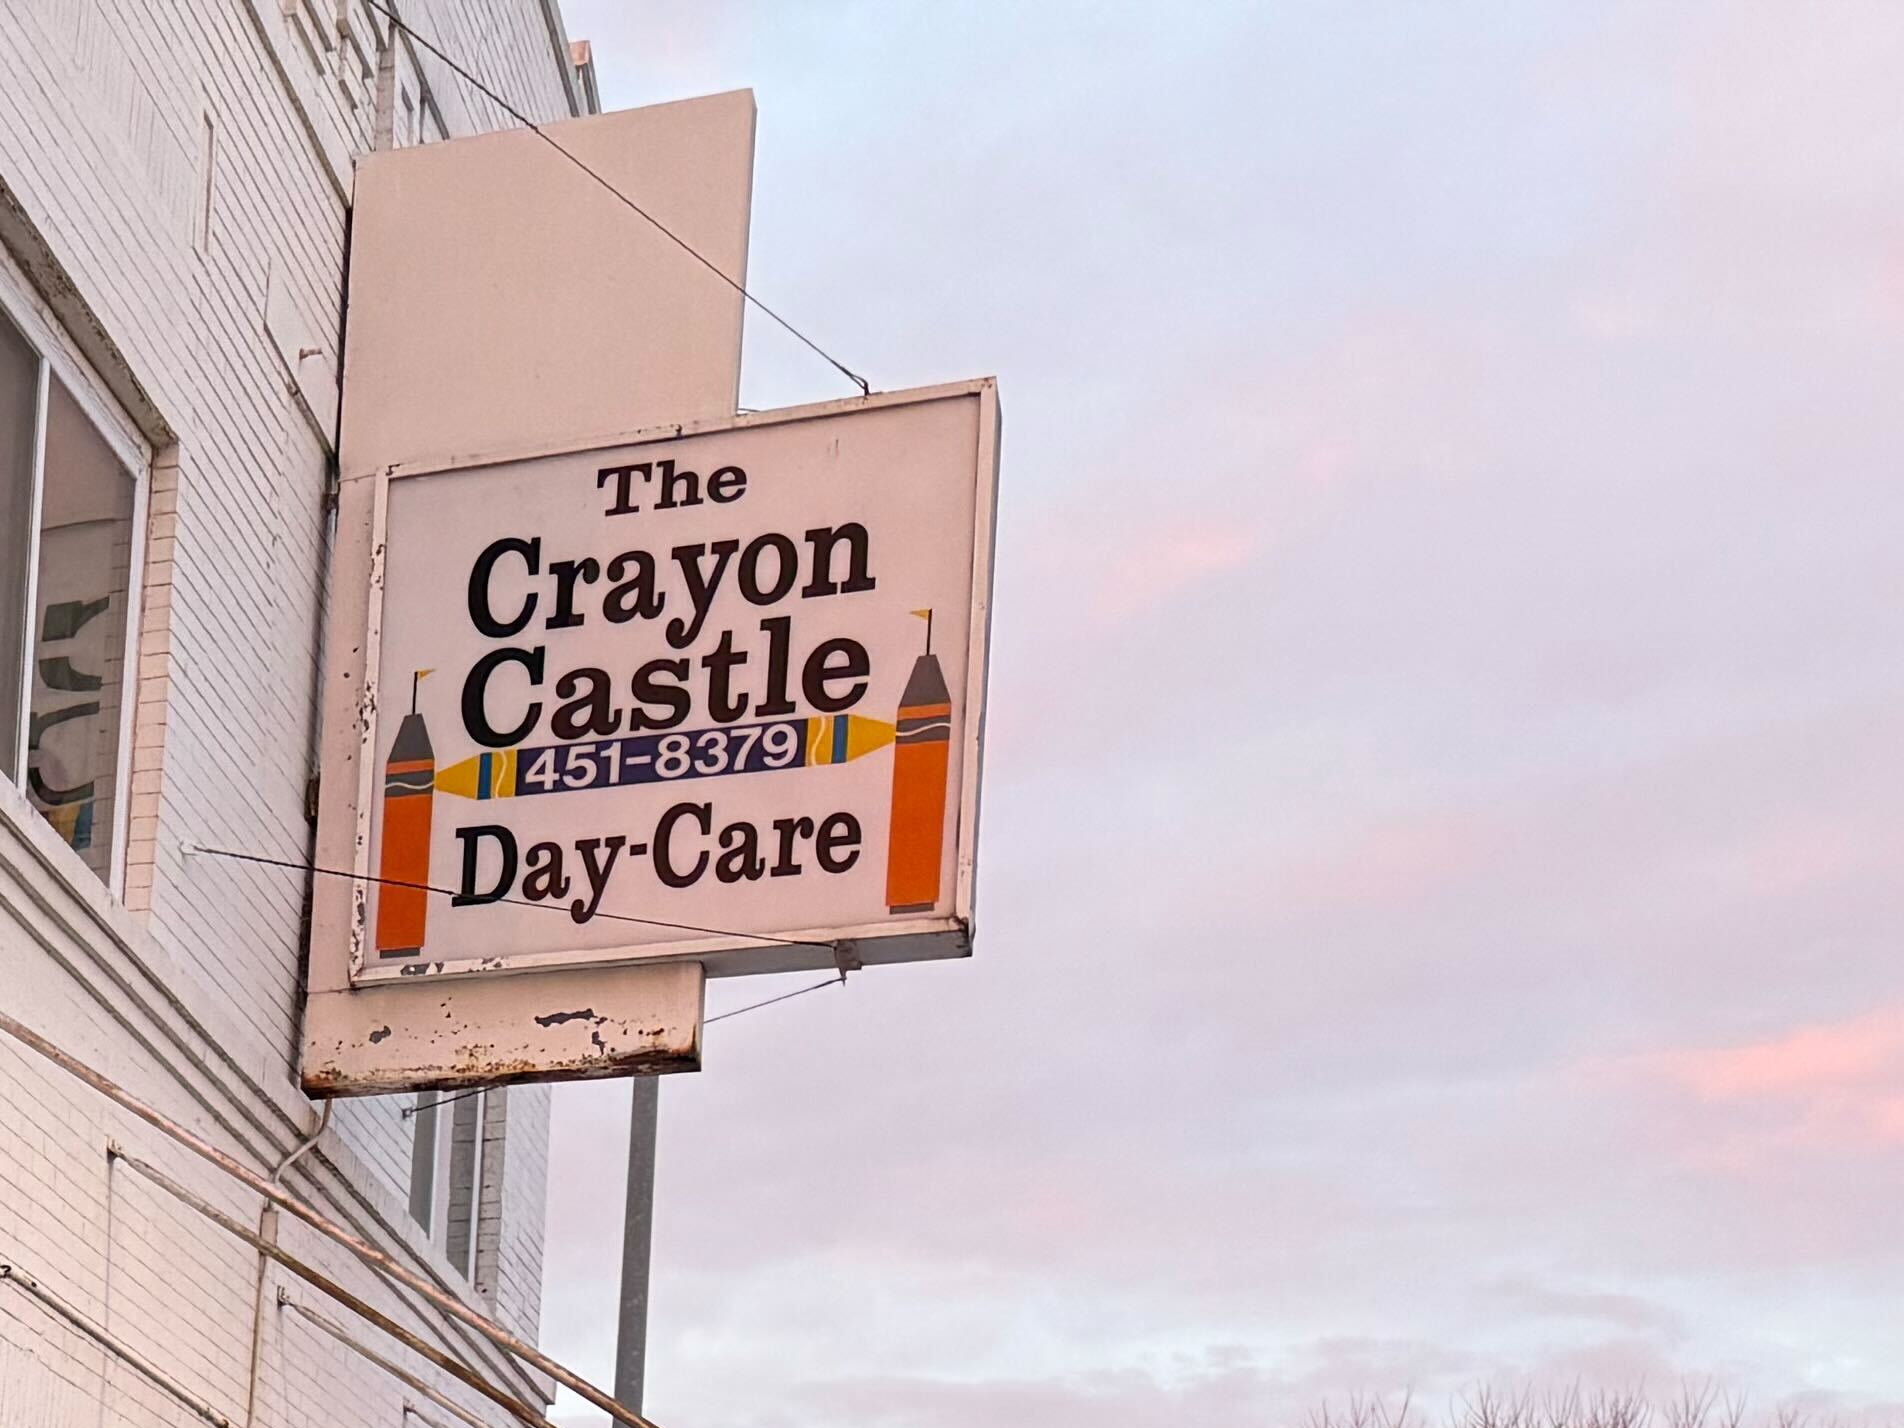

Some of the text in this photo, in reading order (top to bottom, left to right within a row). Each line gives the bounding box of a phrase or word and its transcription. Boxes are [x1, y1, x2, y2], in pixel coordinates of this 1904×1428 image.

[597, 459, 747, 518] The
[467, 520, 876, 649] Crayon
[460, 617, 870, 748] Castle
[524, 723, 799, 791] 451-8379
[451, 802, 863, 925] Day-Care
